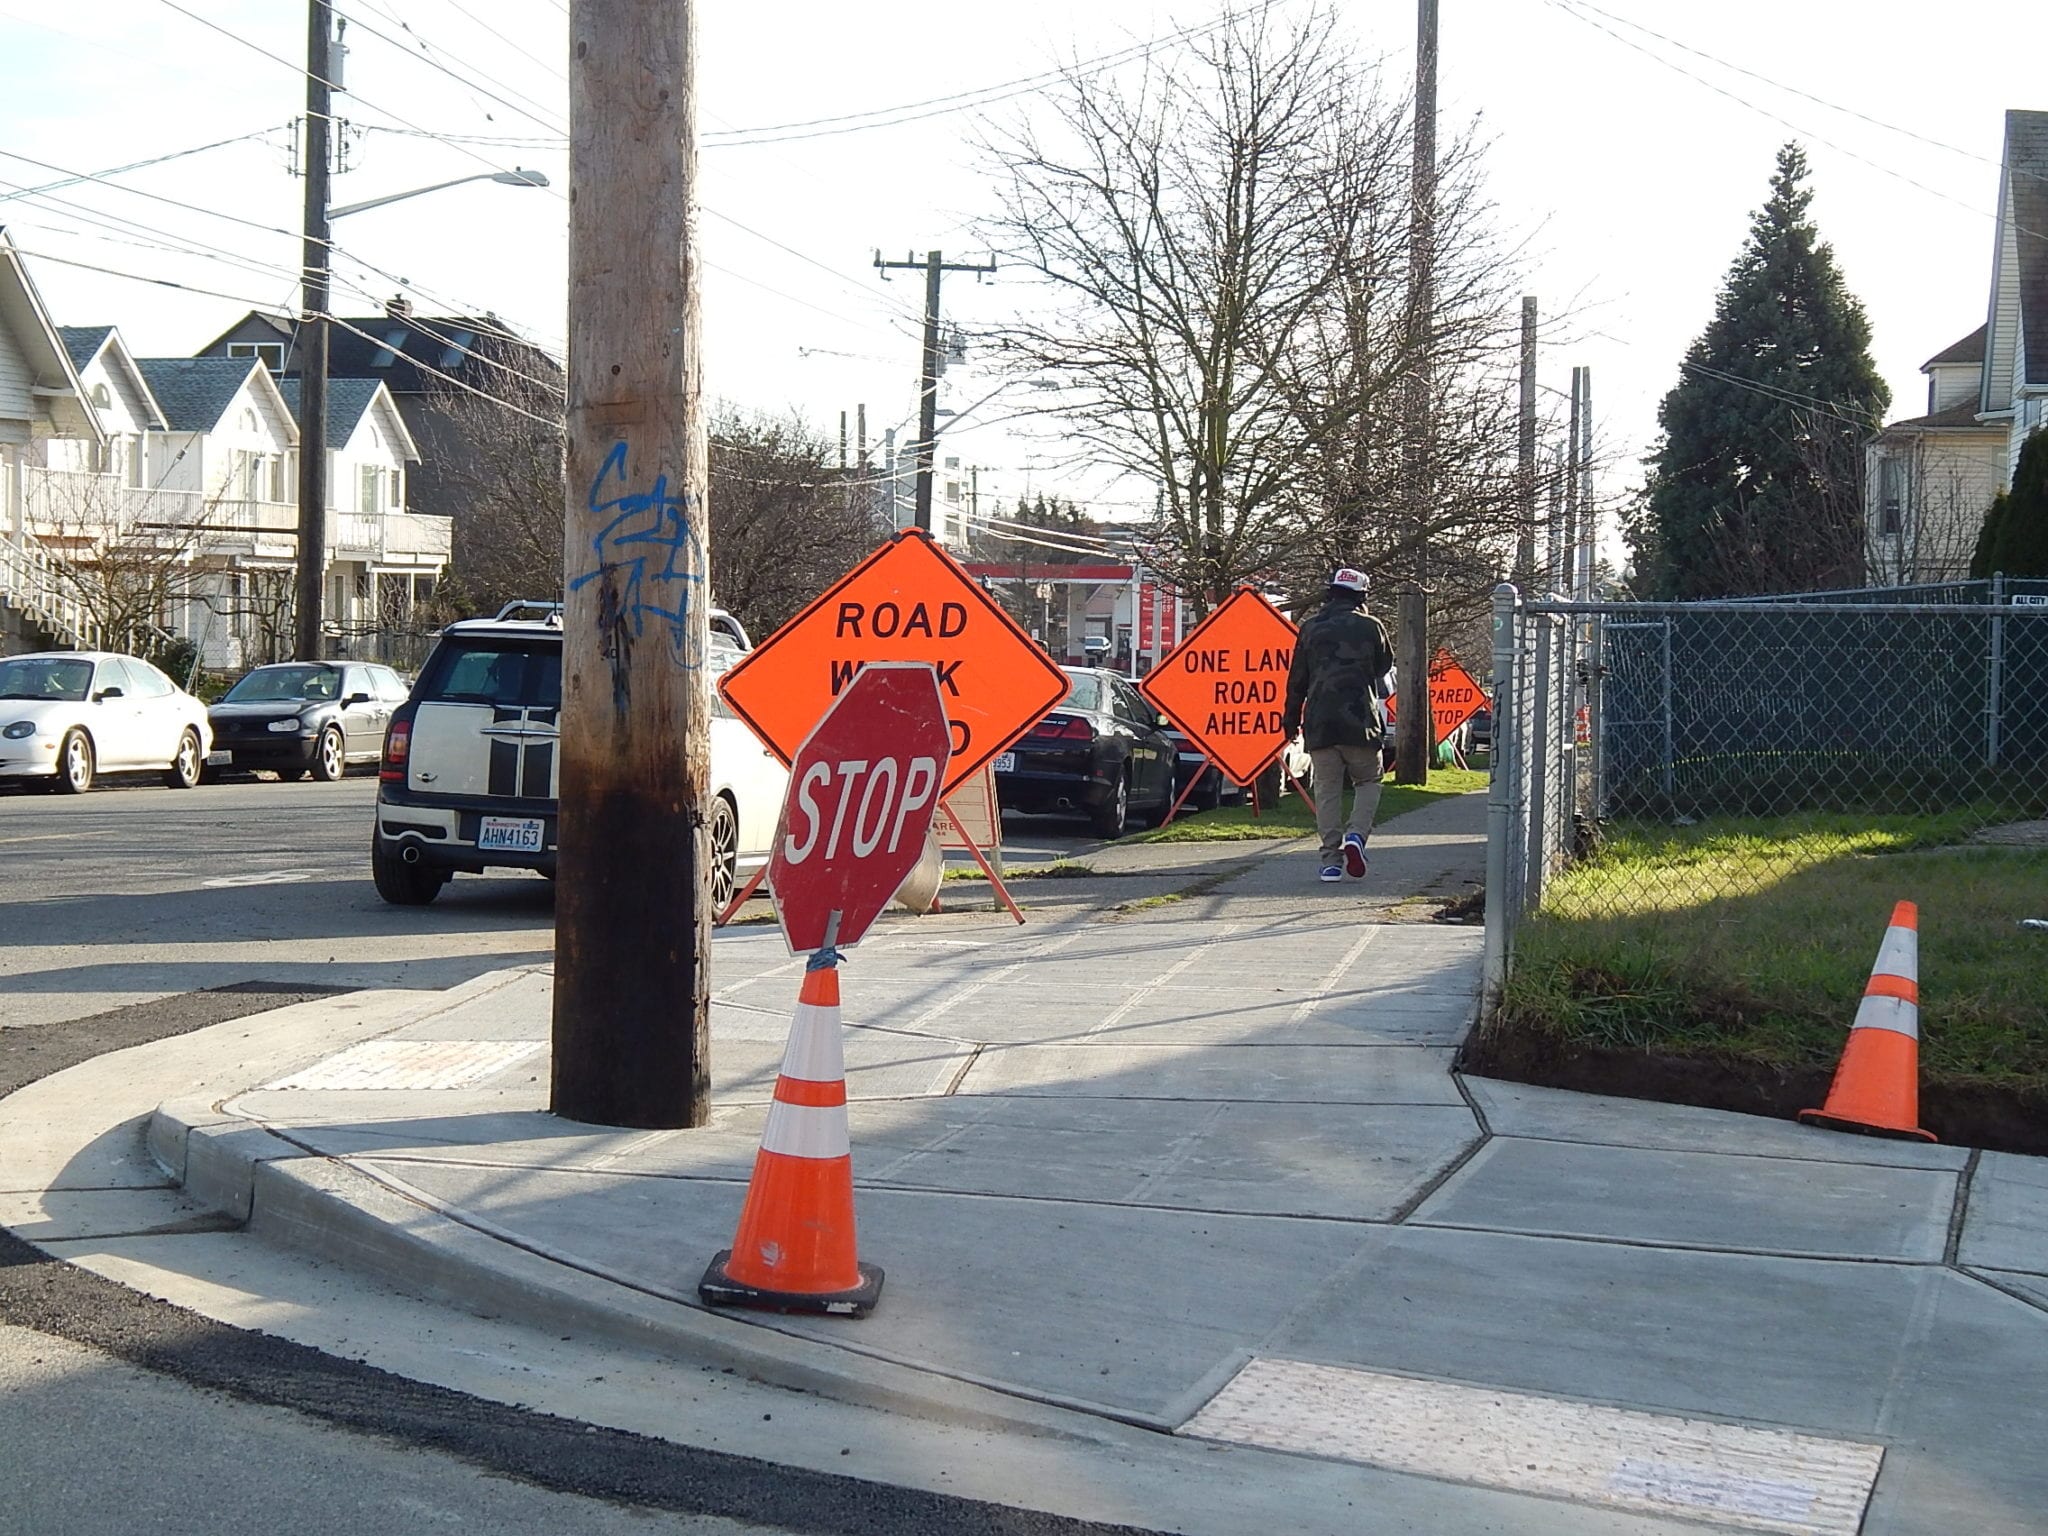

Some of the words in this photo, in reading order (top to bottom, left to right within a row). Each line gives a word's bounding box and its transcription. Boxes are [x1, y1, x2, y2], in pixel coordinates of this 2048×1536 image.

[836, 602, 967, 638] ROAD
[1185, 650, 1230, 673] ONE
[1245, 649, 1290, 672] LAN
[831, 660, 963, 696] WK
[1215, 681, 1277, 704] ROAD
[1429, 689, 1473, 703] PARED
[1205, 712, 1282, 735] AHEAD
[1433, 710, 1464, 725] TOP
[992, 759, 1011, 768] 9953
[784, 756, 937, 865] STOP
[483, 828, 539, 846] AHN4163
